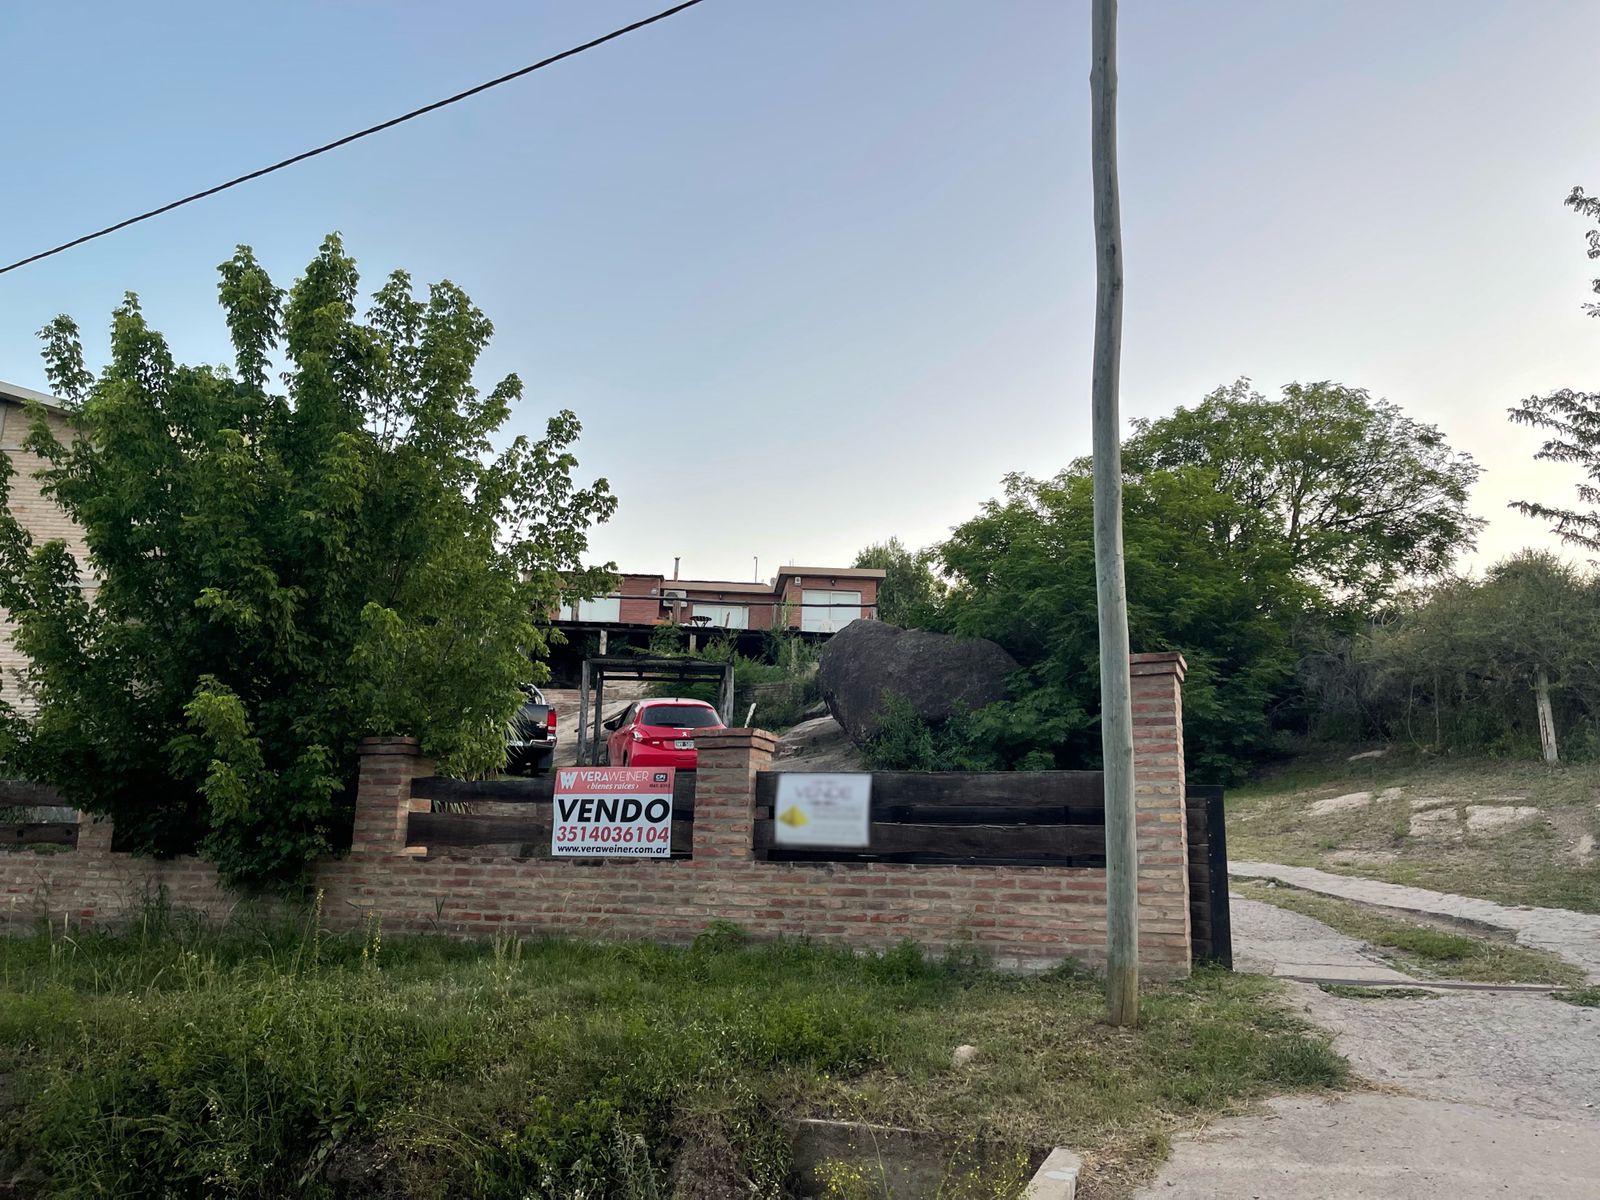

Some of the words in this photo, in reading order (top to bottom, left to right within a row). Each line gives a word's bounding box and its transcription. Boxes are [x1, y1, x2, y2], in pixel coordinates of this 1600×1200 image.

[580, 770, 649, 782] VERAWEINER
[558, 798, 670, 823] VENDO
[556, 826, 669, 843] 3514036104
[557, 844, 668, 854] www.veraweiner.com.ar
